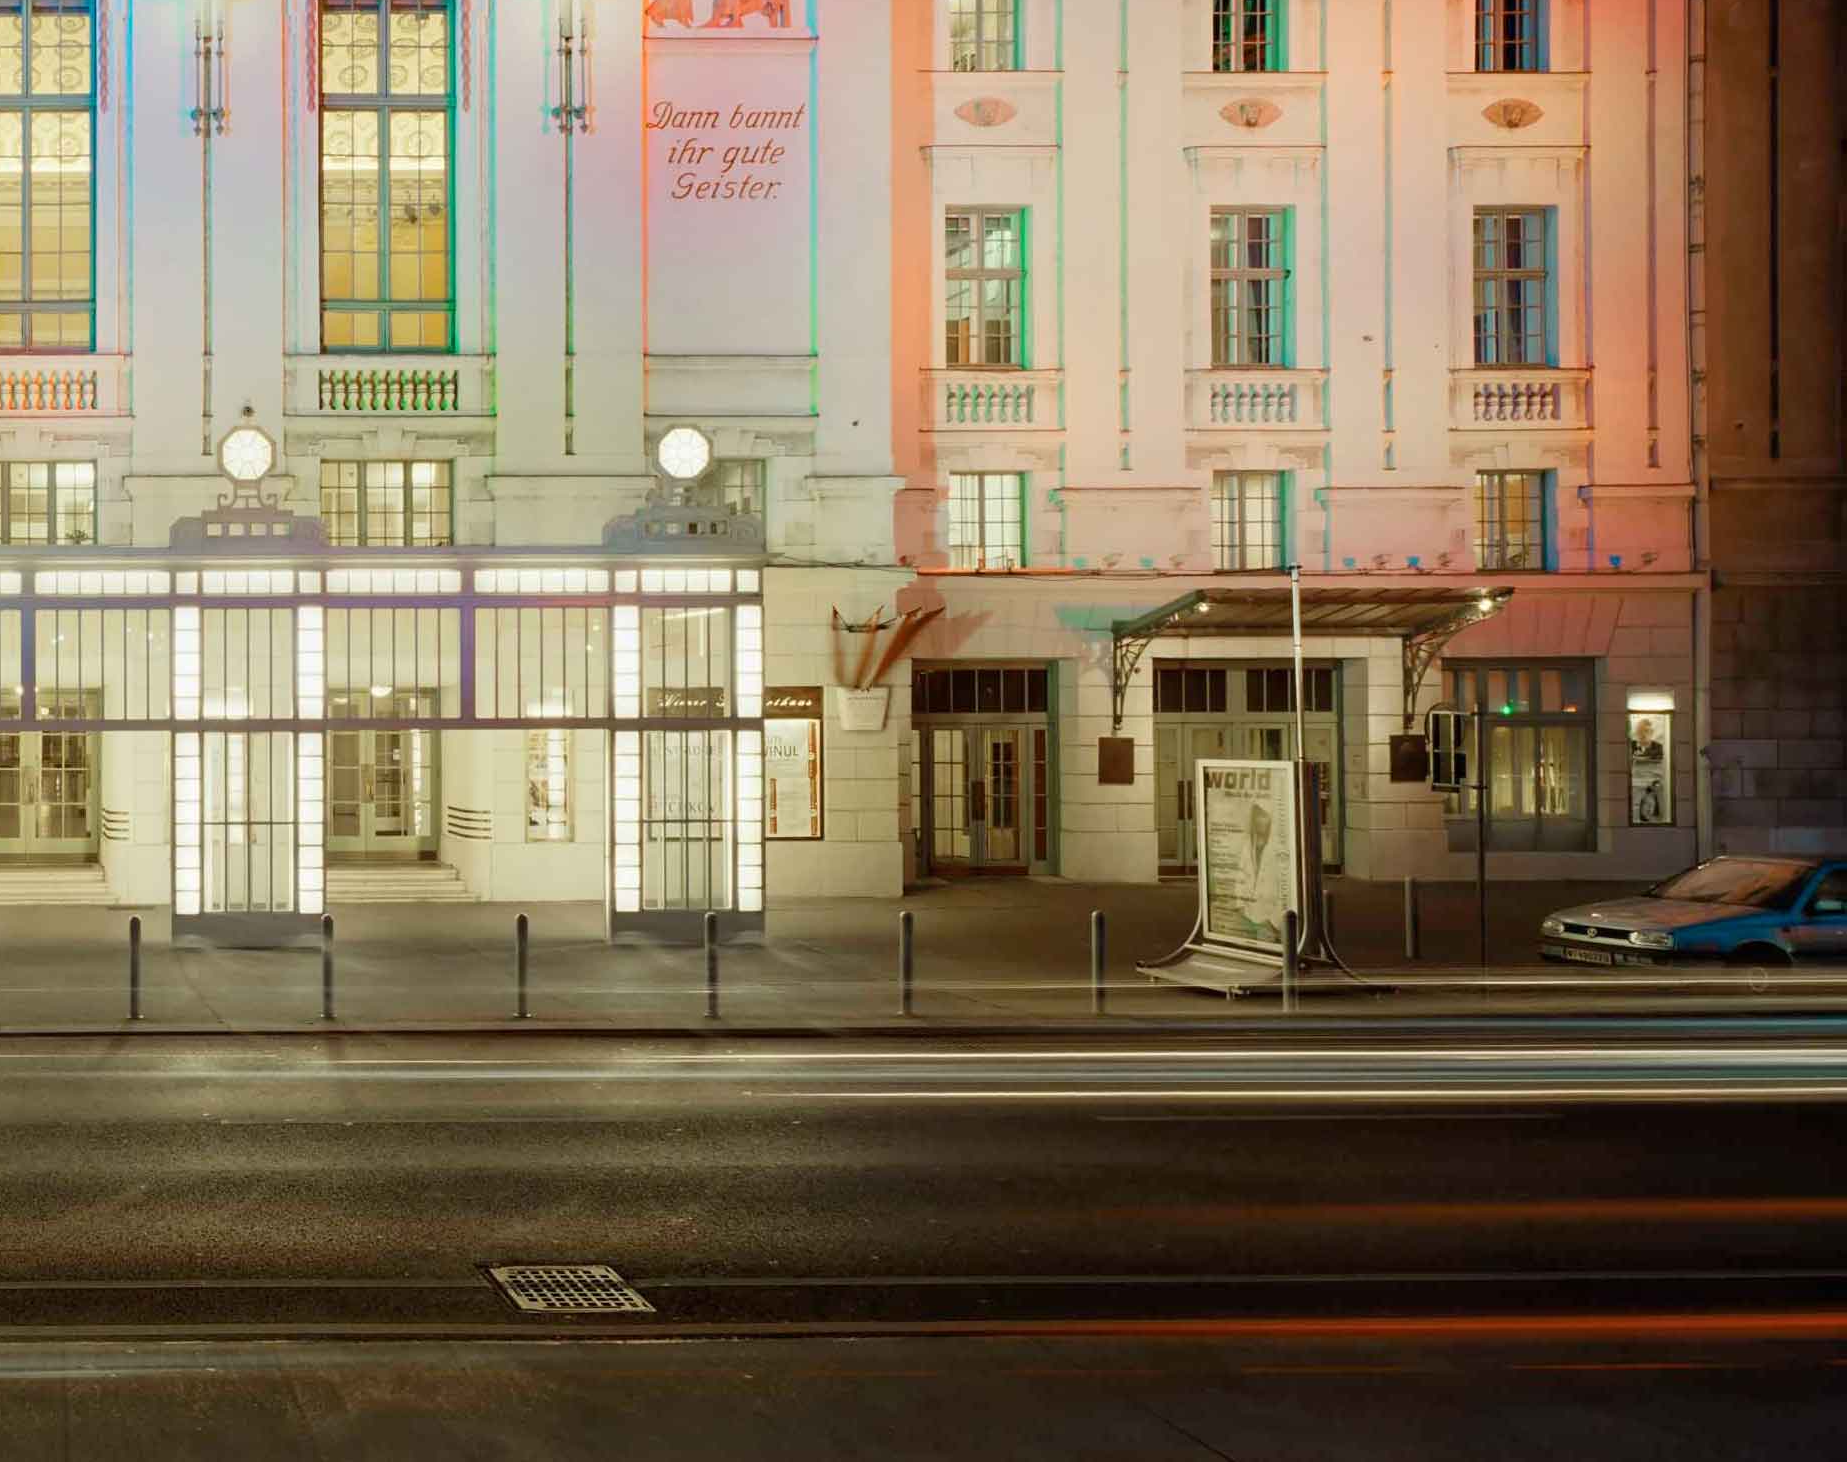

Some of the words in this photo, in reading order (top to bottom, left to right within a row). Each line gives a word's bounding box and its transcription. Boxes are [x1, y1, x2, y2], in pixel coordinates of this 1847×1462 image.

[646, 101, 721, 130] Dann
[729, 102, 807, 130] bannt
[668, 138, 713, 165] ihr
[721, 138, 785, 173] gute
[672, 172, 782, 200] Geister.
[1204, 767, 1271, 790] world
